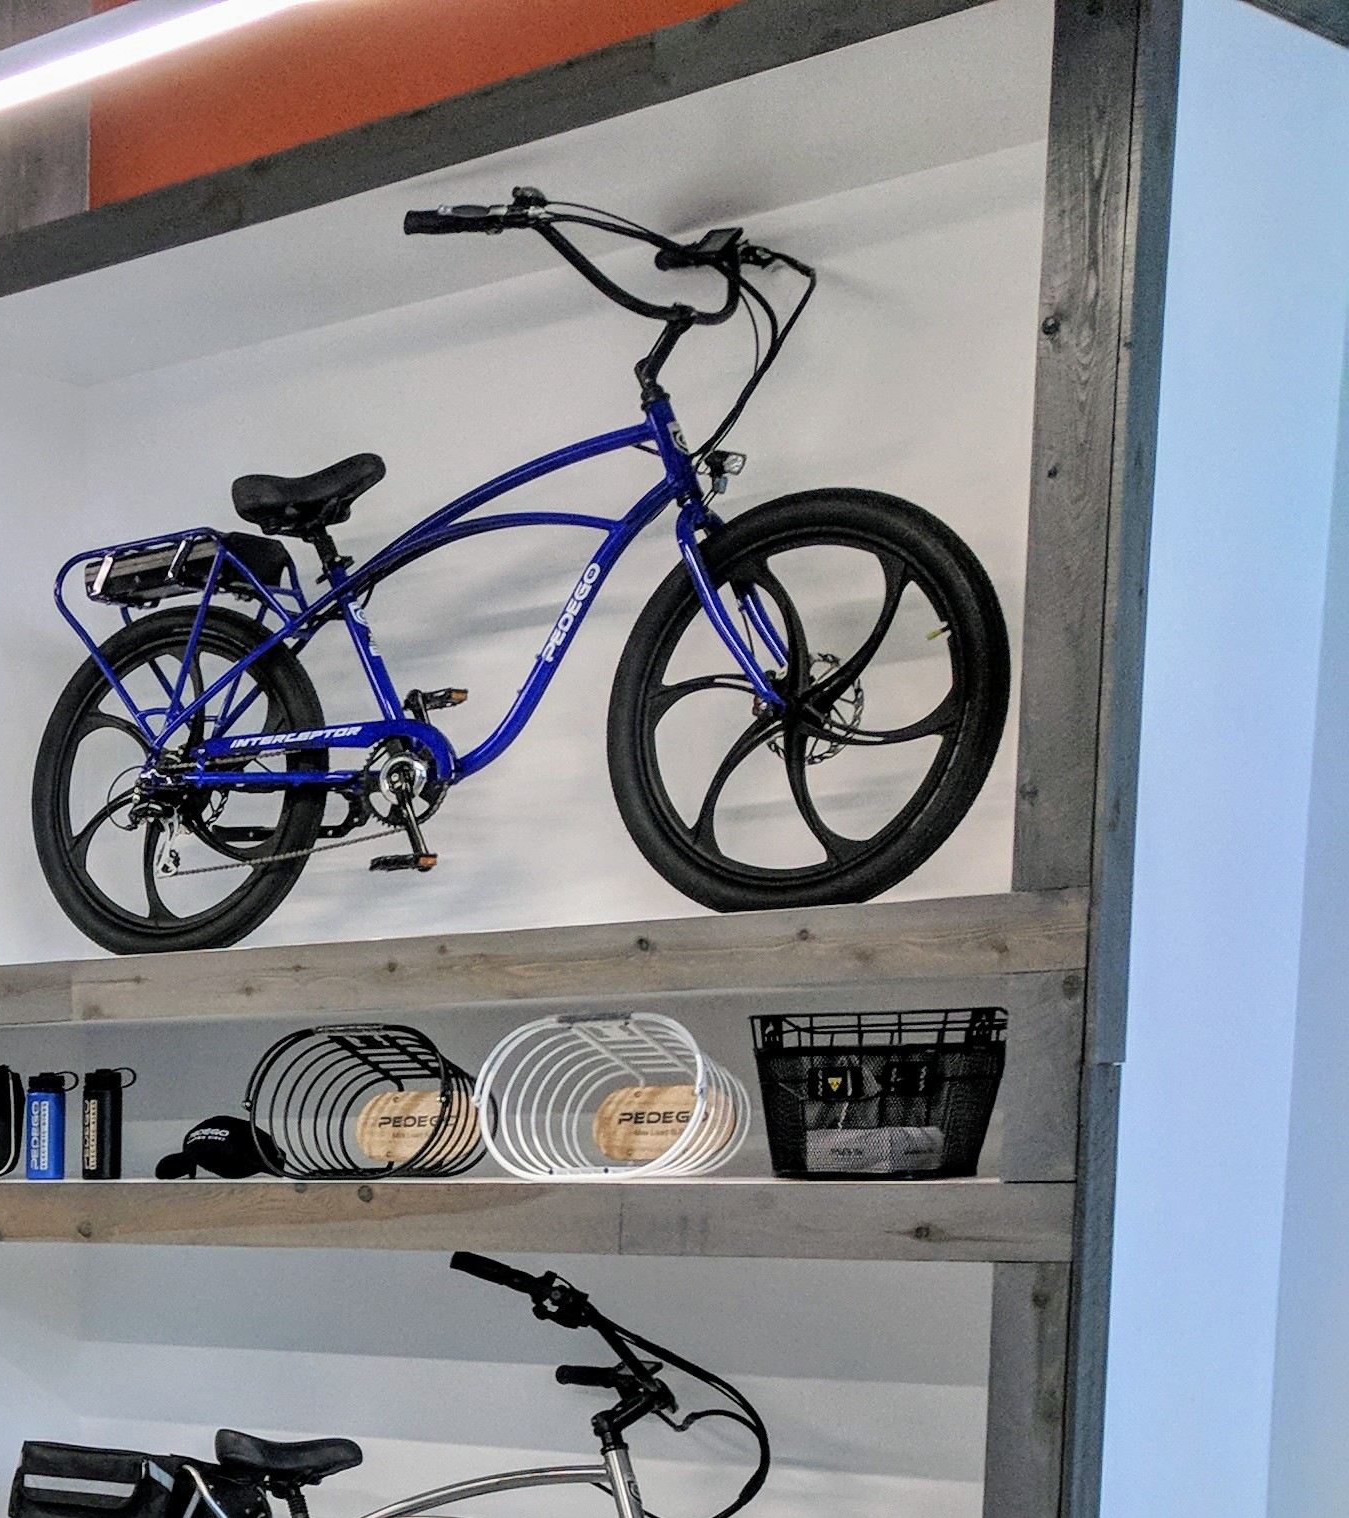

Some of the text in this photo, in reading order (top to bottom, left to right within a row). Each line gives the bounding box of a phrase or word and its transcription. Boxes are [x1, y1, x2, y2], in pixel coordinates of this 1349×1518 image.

[542, 561, 602, 663] PEDEGO
[230, 725, 363, 750] INTERCEPTOR
[31, 1100, 40, 1170] PEDEGO
